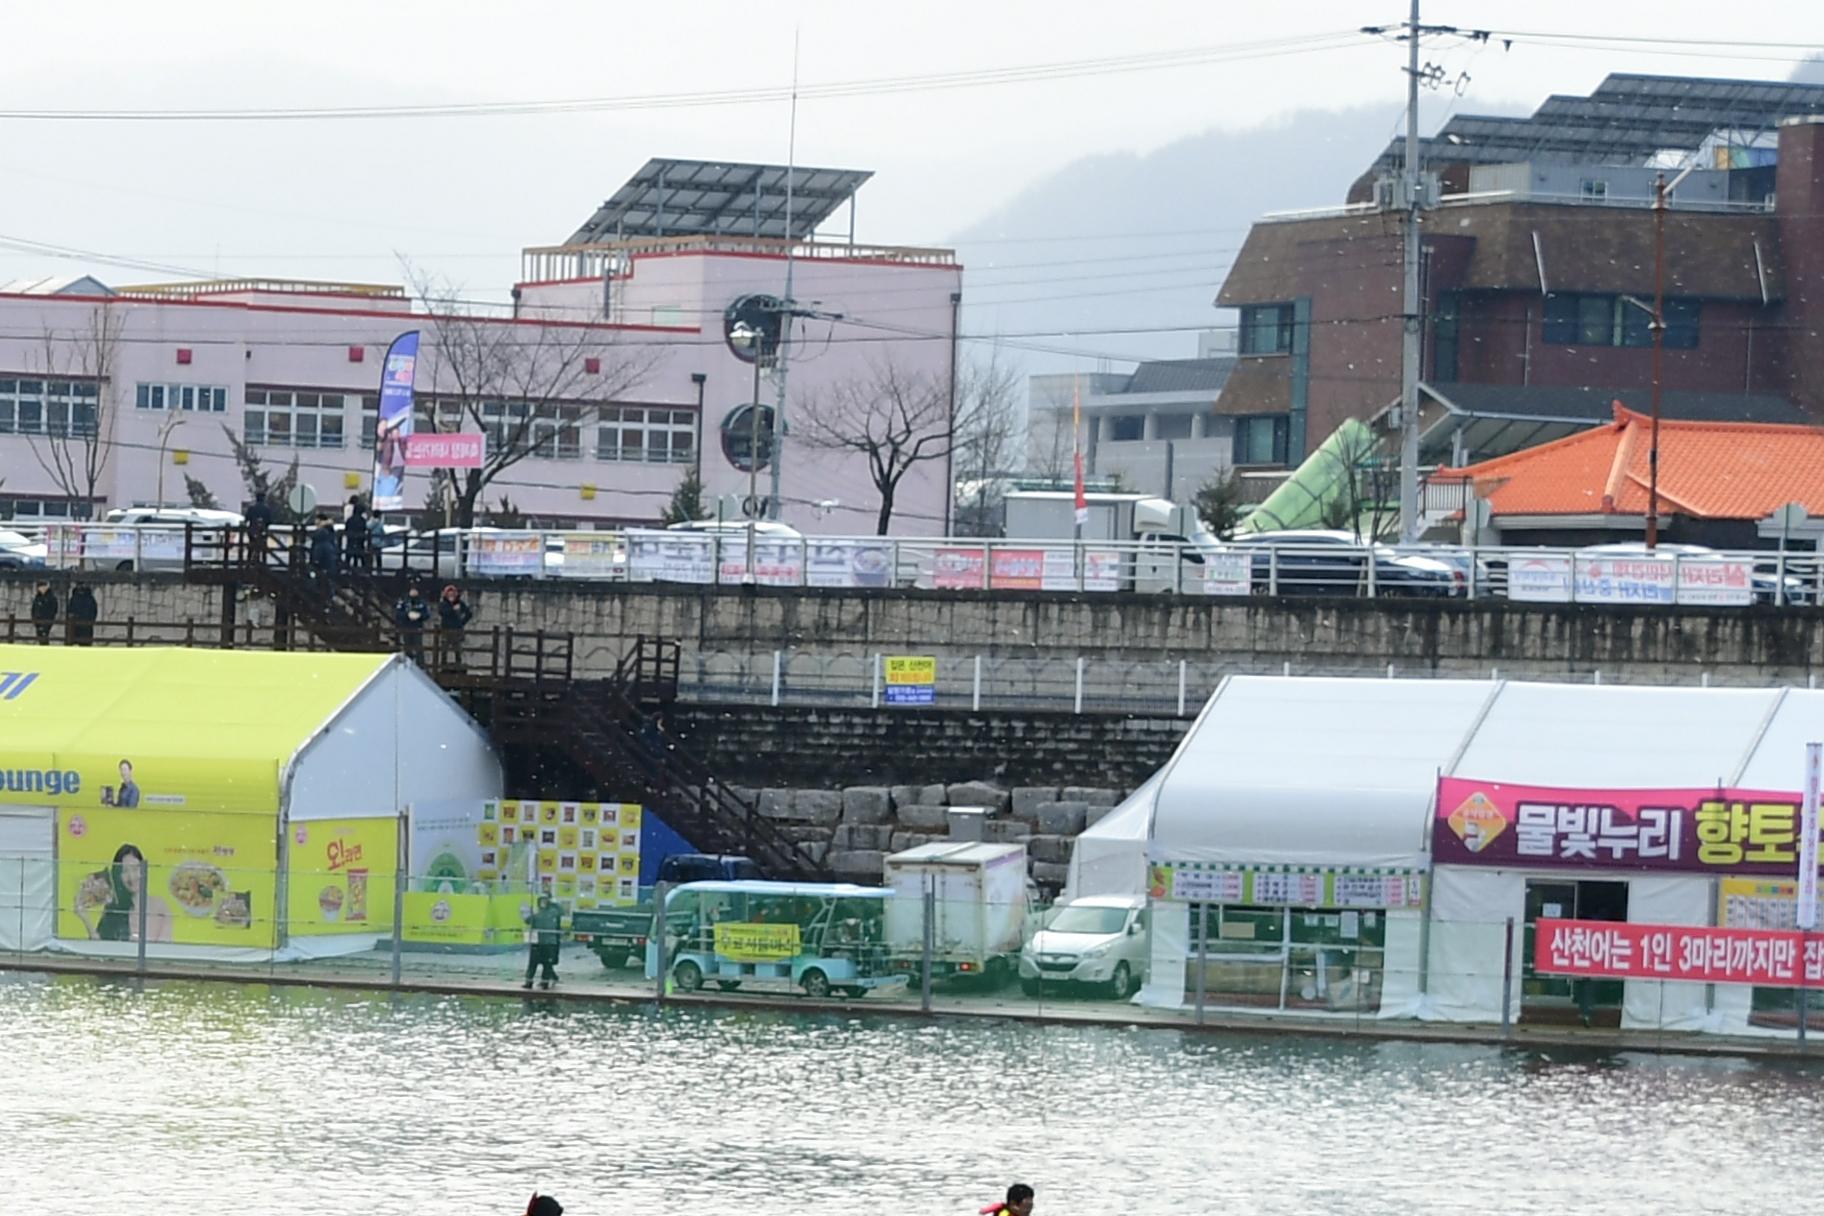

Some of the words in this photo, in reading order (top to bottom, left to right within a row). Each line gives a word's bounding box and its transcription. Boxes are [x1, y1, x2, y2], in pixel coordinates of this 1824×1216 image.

[1515, 803, 1681, 861] 물빛누리
[1550, 927, 1632, 969] 산천어는
[1639, 931, 1673, 973] 1인
[1678, 933, 1796, 978] 3마리까지만
